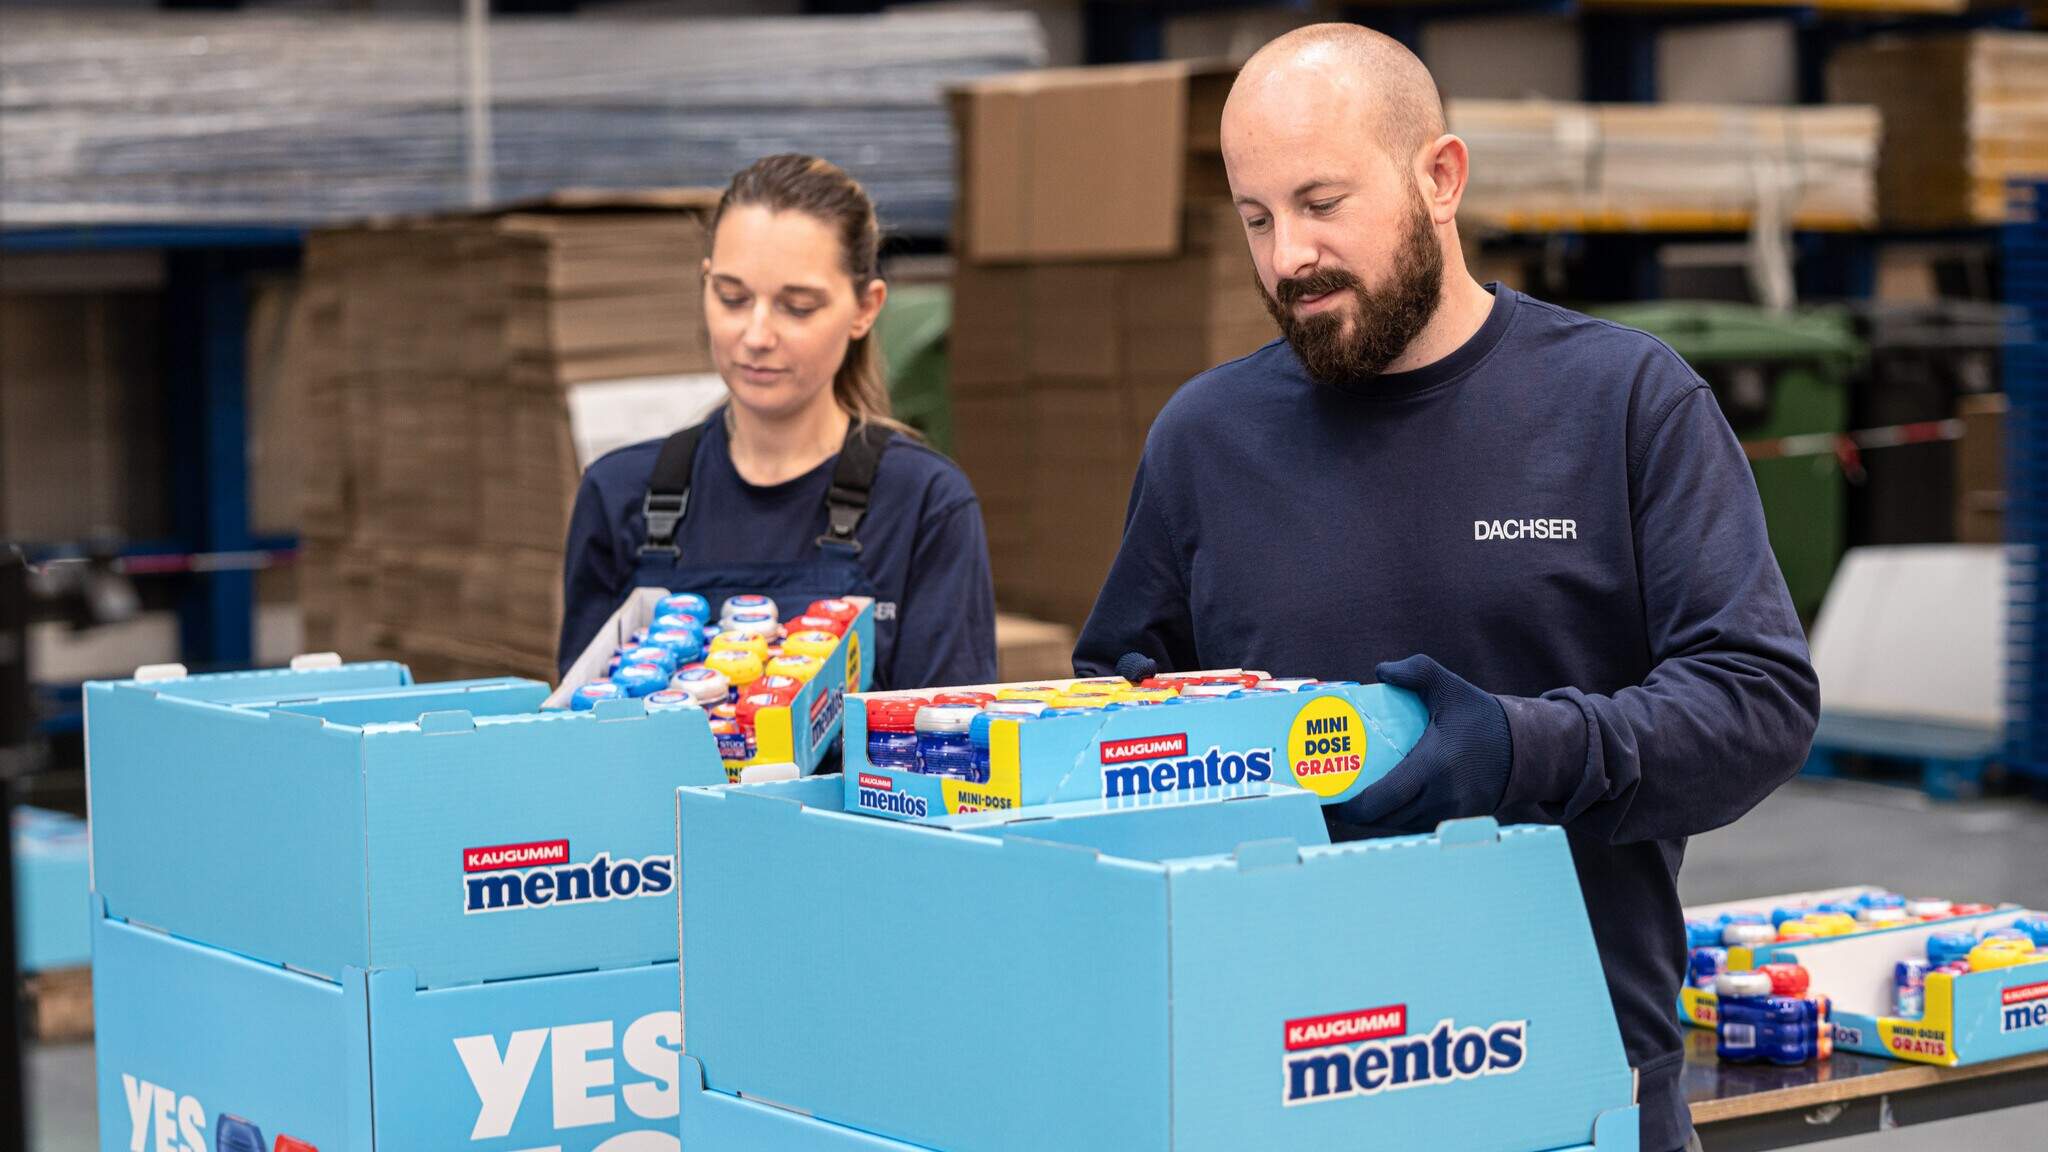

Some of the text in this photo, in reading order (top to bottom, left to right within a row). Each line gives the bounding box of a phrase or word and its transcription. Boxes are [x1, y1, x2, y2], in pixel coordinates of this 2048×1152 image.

[1474, 518, 1578, 541] DACHSER
[1306, 716, 1348, 736] MINI
[1105, 738, 1183, 759] KAUGUMMI
[1305, 736, 1351, 756] DOSE
[1104, 749, 1273, 798] mentos
[1296, 754, 1361, 777] GRATIS
[859, 790, 927, 818] mentos
[958, 790, 1012, 809] MINI-DOSE
[468, 844, 564, 867] KAUGUMMI
[466, 856, 672, 911] mentos
[1289, 1011, 1401, 1044] KAUGUMMI
[2004, 1003, 2048, 1031] me
[1892, 1036, 1945, 1056] GRATIS
[1287, 1024, 1523, 1101] mentos
[452, 1010, 681, 1141] YES
[121, 1072, 207, 1152] YES
